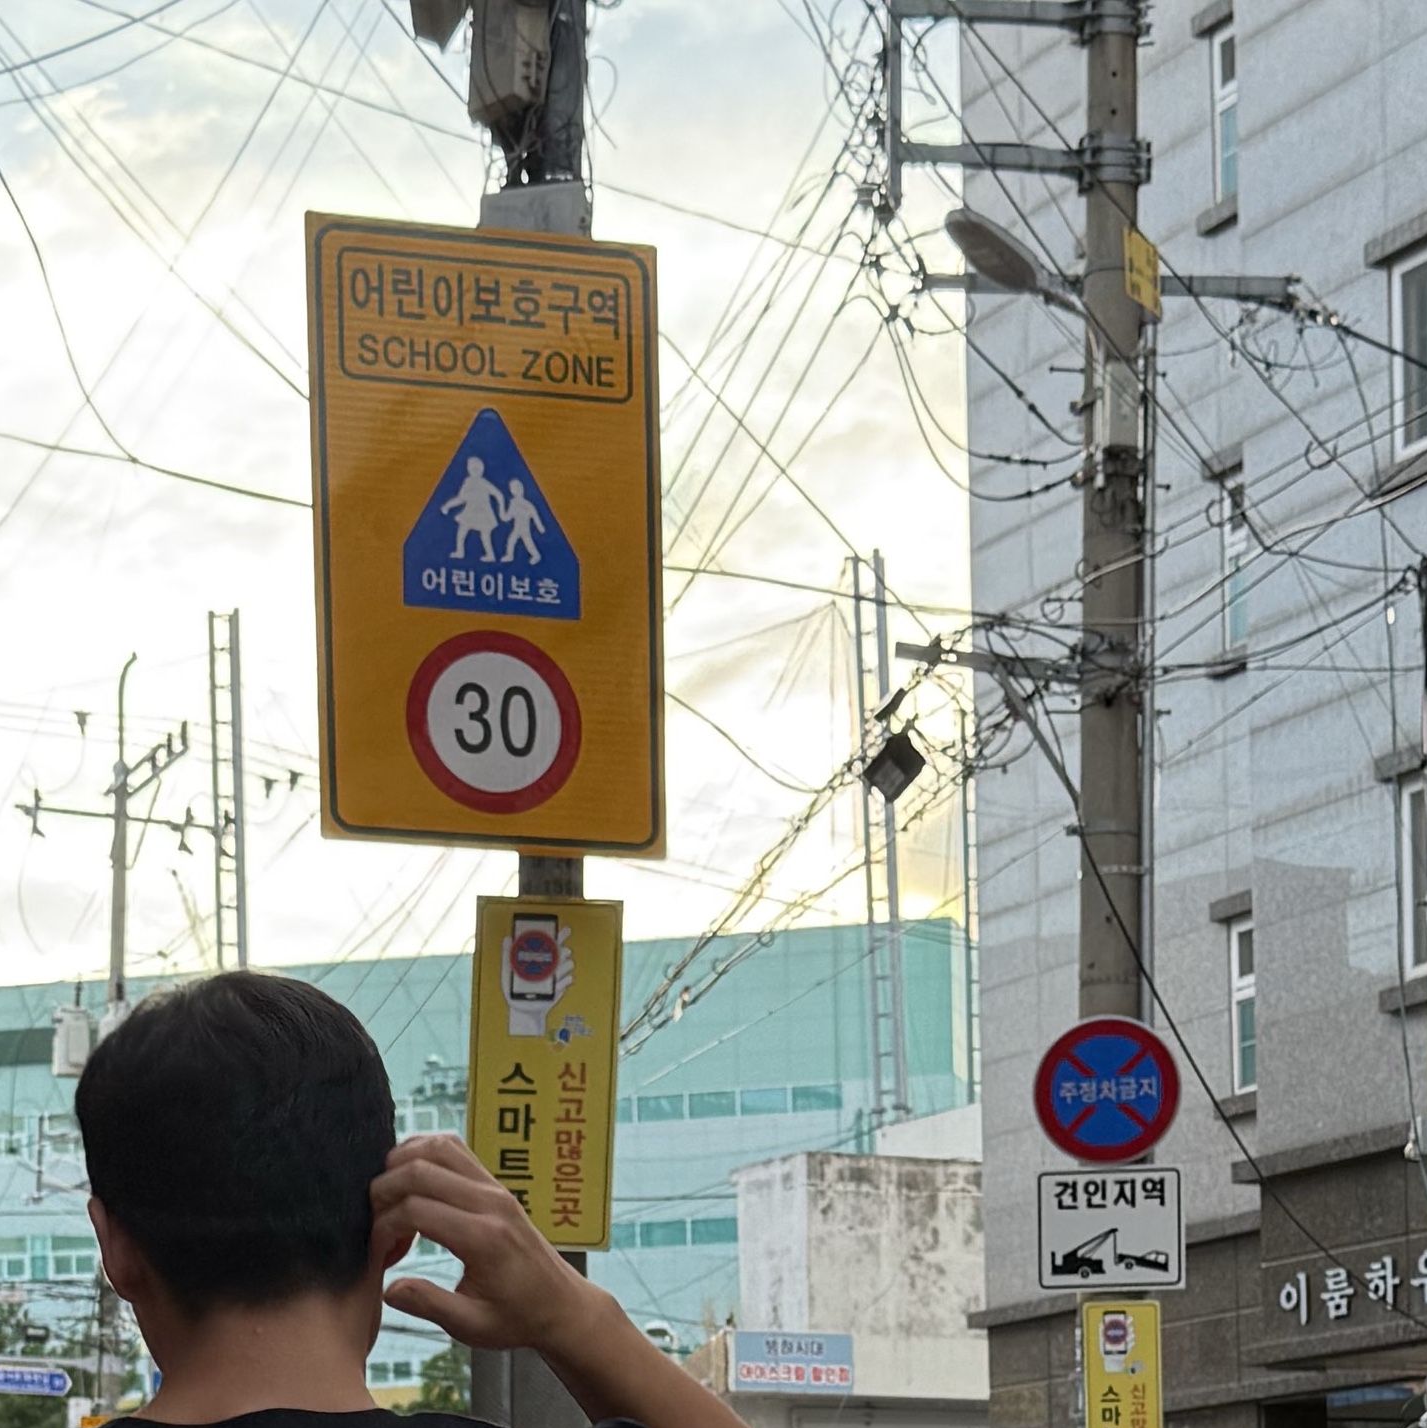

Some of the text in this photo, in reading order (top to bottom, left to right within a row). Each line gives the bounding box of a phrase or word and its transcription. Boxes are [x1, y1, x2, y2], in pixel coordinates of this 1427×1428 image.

[350, 261, 622, 341] 어린이보호구역
[357, 334, 616, 388] SCHOOL ZONE
[422, 566, 562, 606] 어린이보호
[454, 681, 538, 758] 30
[1058, 1076, 1158, 1104] 주정차금지
[1053, 1177, 1166, 1210] 견인지역
